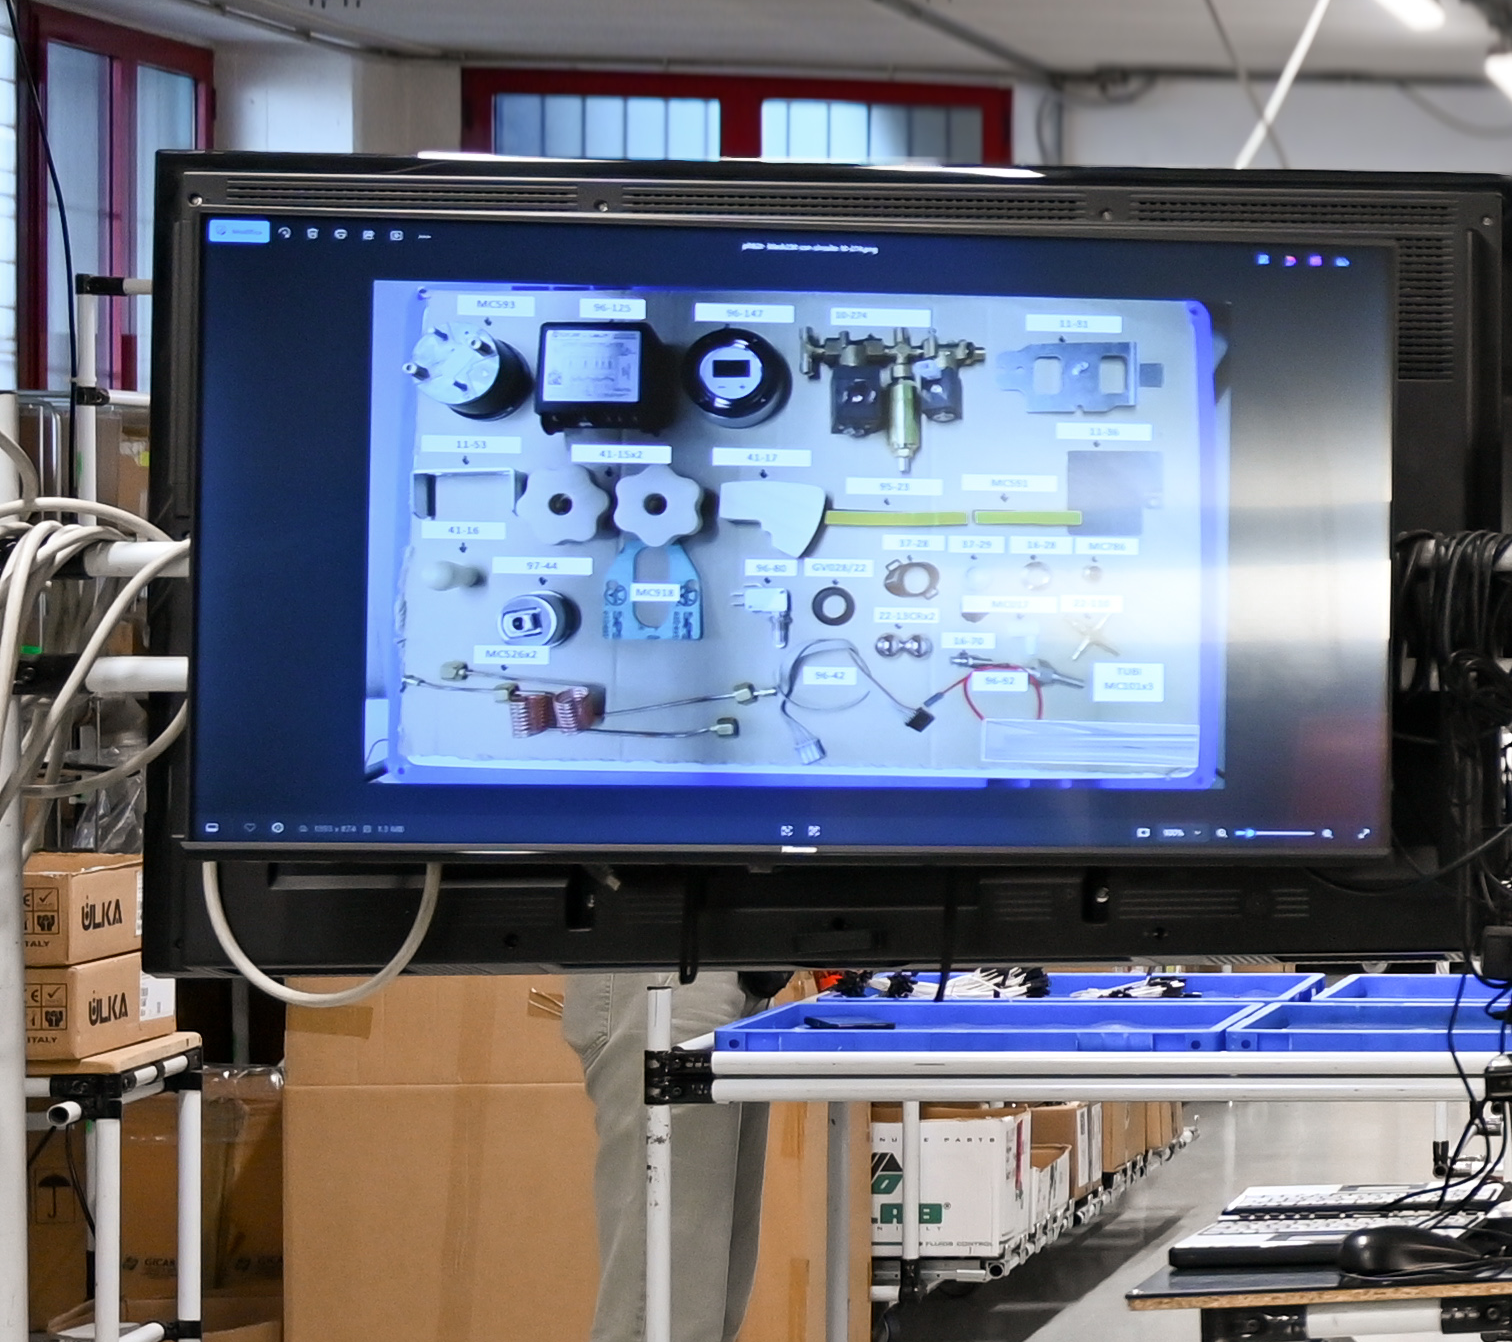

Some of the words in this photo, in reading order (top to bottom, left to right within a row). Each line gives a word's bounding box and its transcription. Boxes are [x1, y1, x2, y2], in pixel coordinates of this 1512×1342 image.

[594, 303, 632, 314] 96-125
[726, 308, 763, 318] 96-147
[456, 440, 487, 450] 11-53
[599, 449, 643, 460] 41-15x2
[747, 453, 778, 463] 41-17
[448, 526, 480, 536] 41-16
[526, 561, 558, 571] 97-44
[485, 649, 538, 659] MC526x2
